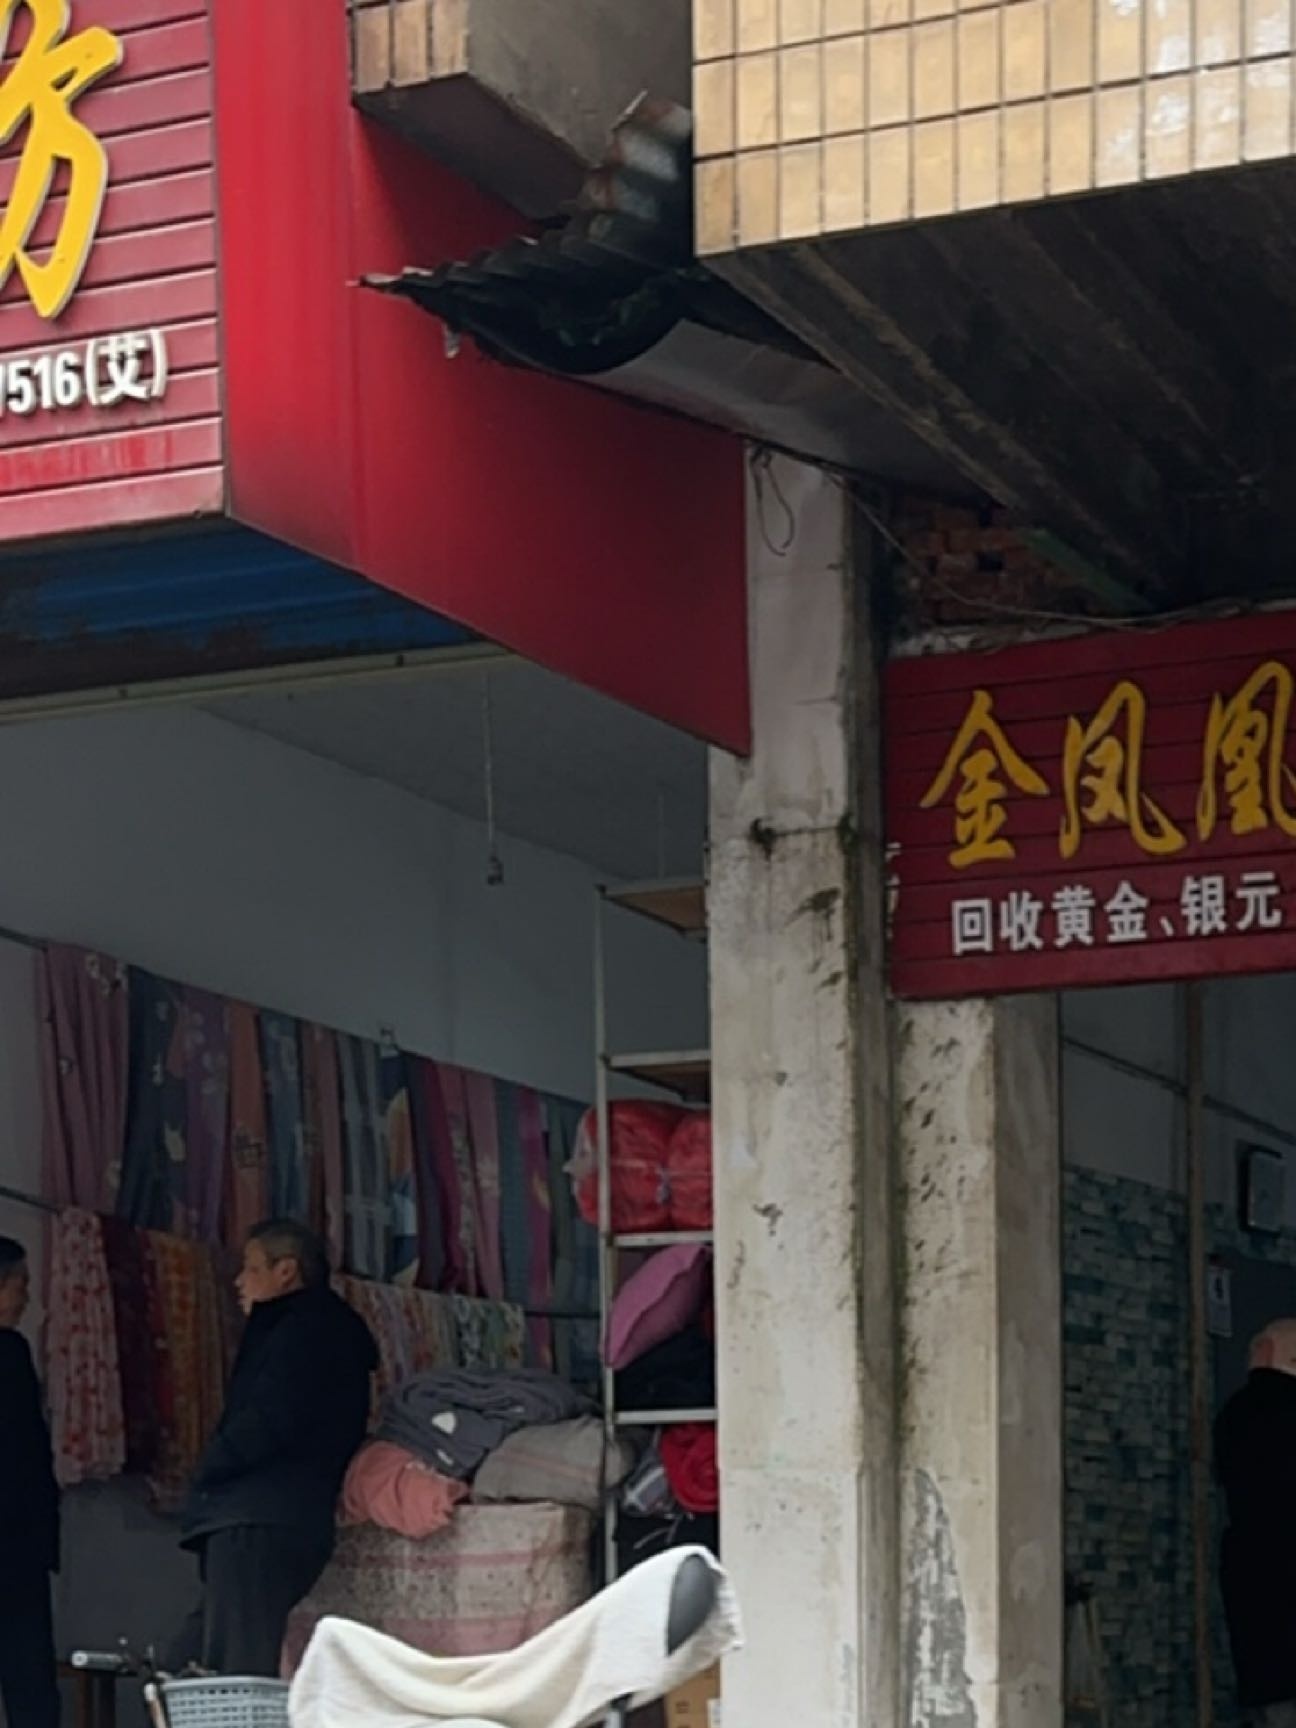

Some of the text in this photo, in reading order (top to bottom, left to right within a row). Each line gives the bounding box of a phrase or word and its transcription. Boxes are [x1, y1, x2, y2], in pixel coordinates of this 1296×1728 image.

[0, 329, 167, 417] 516(艾)
[951, 871, 1282, 956] 回收黄金、银元
